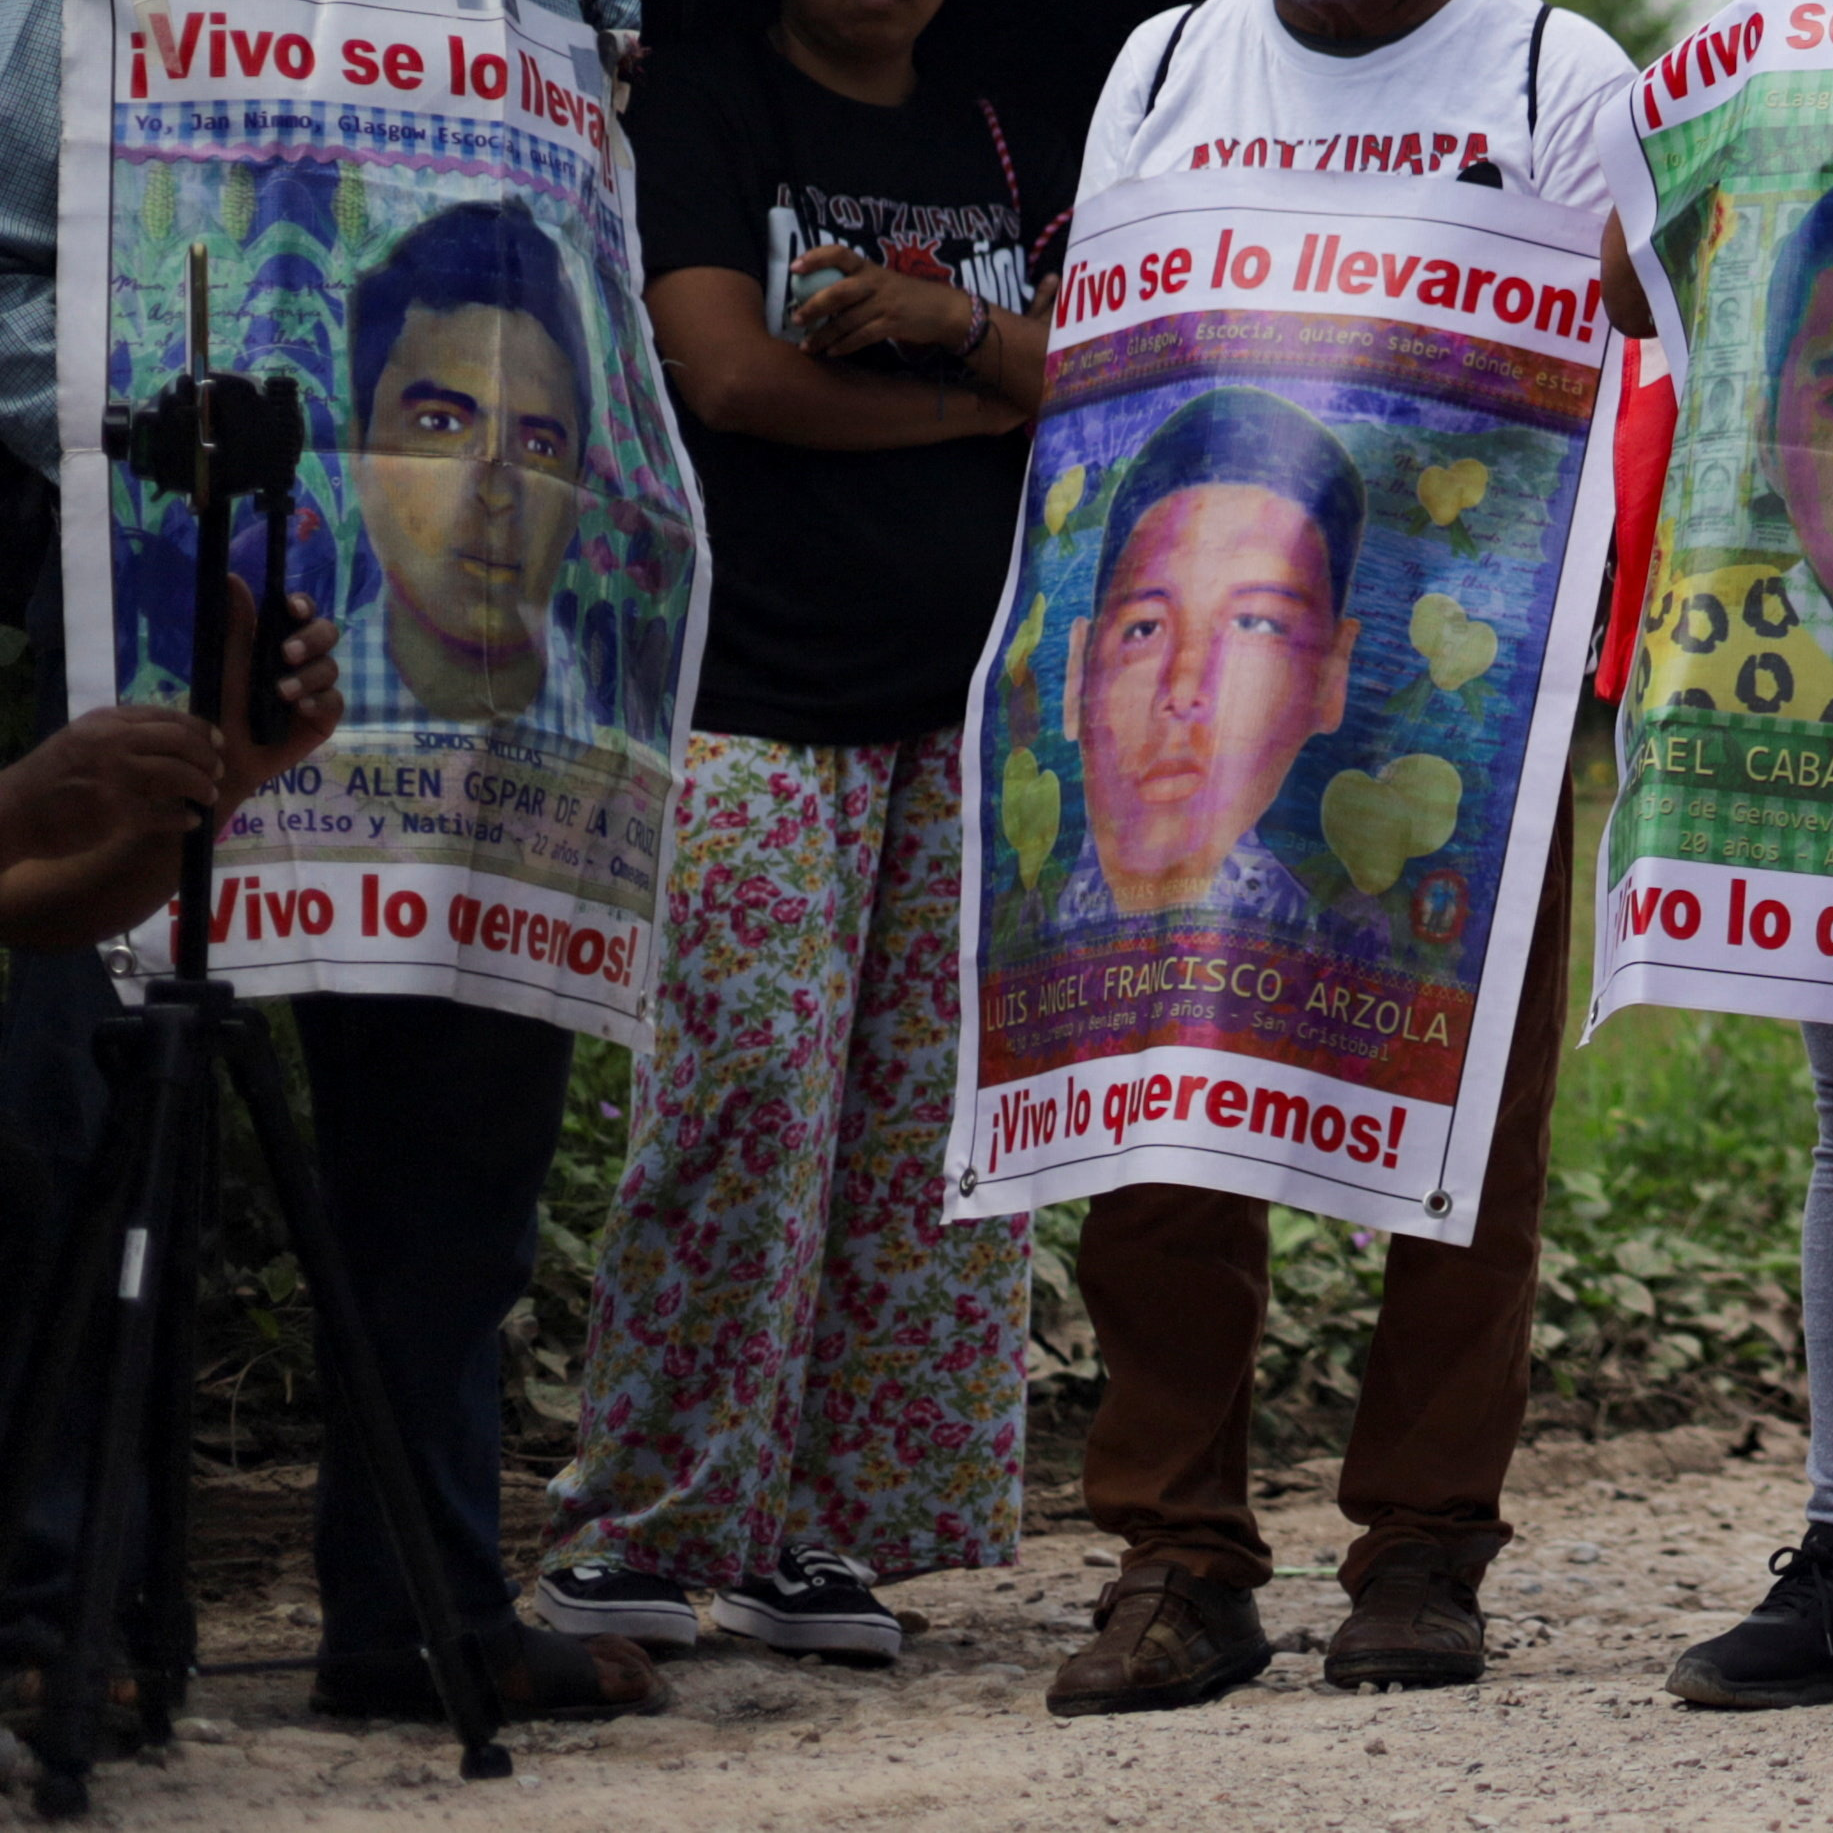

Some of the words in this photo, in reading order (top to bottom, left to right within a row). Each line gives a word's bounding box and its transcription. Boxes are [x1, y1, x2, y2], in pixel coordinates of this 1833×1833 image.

[130, 12, 316, 99] ¡Vivo
[341, 35, 425, 91] se
[448, 35, 509, 101] lo
[1642, 11, 1765, 130] ¡Vivo
[135, 114, 173, 135] Yo,
[190, 113, 230, 132] Jan
[243, 110, 322, 133] Nimmo,
[338, 114, 427, 143] Glasgow
[1138, 248, 1193, 302] se
[1210, 228, 1272, 291] lo
[1292, 232, 1602, 344] llevaron!
[1126, 332, 1185, 358] Glasgow,
[1195, 322, 1285, 344] Escocia,
[1299, 325, 1375, 348] quiero
[1387, 334, 1451, 361] saber
[1462, 348, 1525, 380] dónde
[1535, 369, 1585, 397] está
[413, 731, 476, 752] SOMOS
[232, 813, 264, 836] de
[277, 808, 354, 834] Celso
[368, 814, 387, 840] y
[531, 832, 550, 857] 22
[551, 840, 580, 868] años
[346, 766, 443, 799] ALEN
[555, 794, 581, 828] DE
[585, 800, 609, 838] LA
[626, 816, 656, 858] CRUZ
[1688, 795, 1718, 820] de
[1679, 831, 1709, 854] 20
[1722, 836, 1780, 863] años
[360, 872, 429, 939] lo
[1726, 877, 1793, 951] lo
[985, 986, 1029, 1032] LUÍS
[1038, 975, 1089, 1017] ÁNGEL
[1102, 955, 1284, 1002] FRANCISCO
[1304, 981, 1450, 1048] ARZOLA
[1169, 999, 1216, 1019] años
[1252, 1010, 1287, 1032] San
[988, 1088, 1057, 1174] ¡Vivo
[1065, 1075, 1091, 1138] lo
[1102, 1072, 1407, 1170] queremos!
